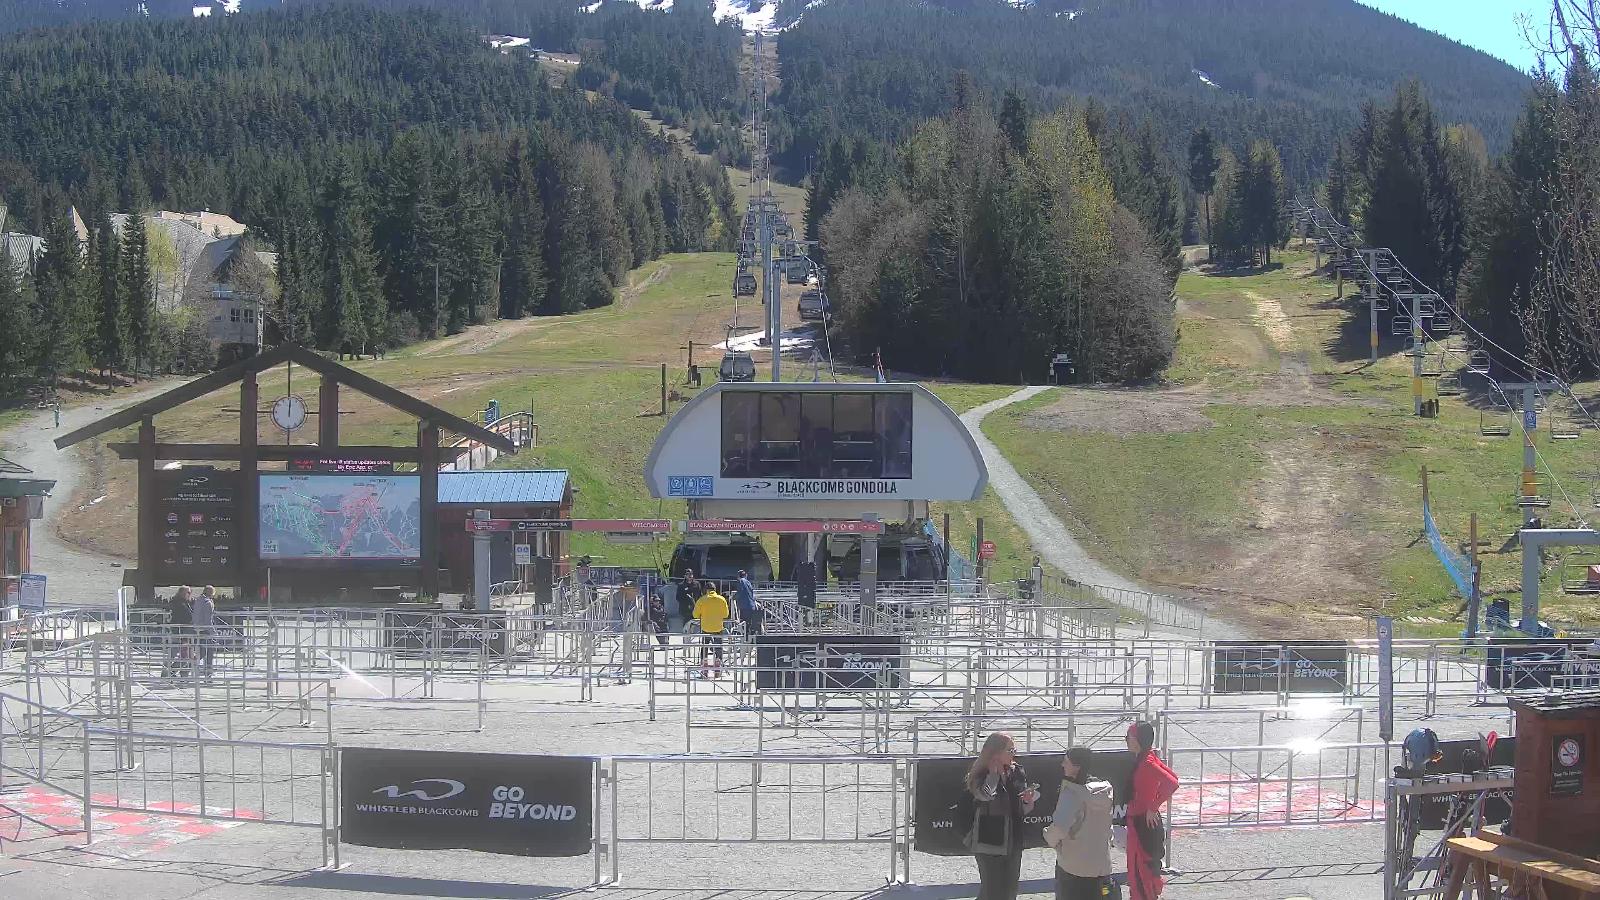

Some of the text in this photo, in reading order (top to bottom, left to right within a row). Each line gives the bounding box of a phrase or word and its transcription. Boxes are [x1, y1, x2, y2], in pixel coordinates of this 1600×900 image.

[778, 482, 897, 494] BLACKCOMB GONDOLA
[1296, 660, 1312, 669] GO
[1294, 669, 1338, 678] BEYOND
[492, 786, 524, 801] GO
[488, 802, 576, 820] BEYOND
